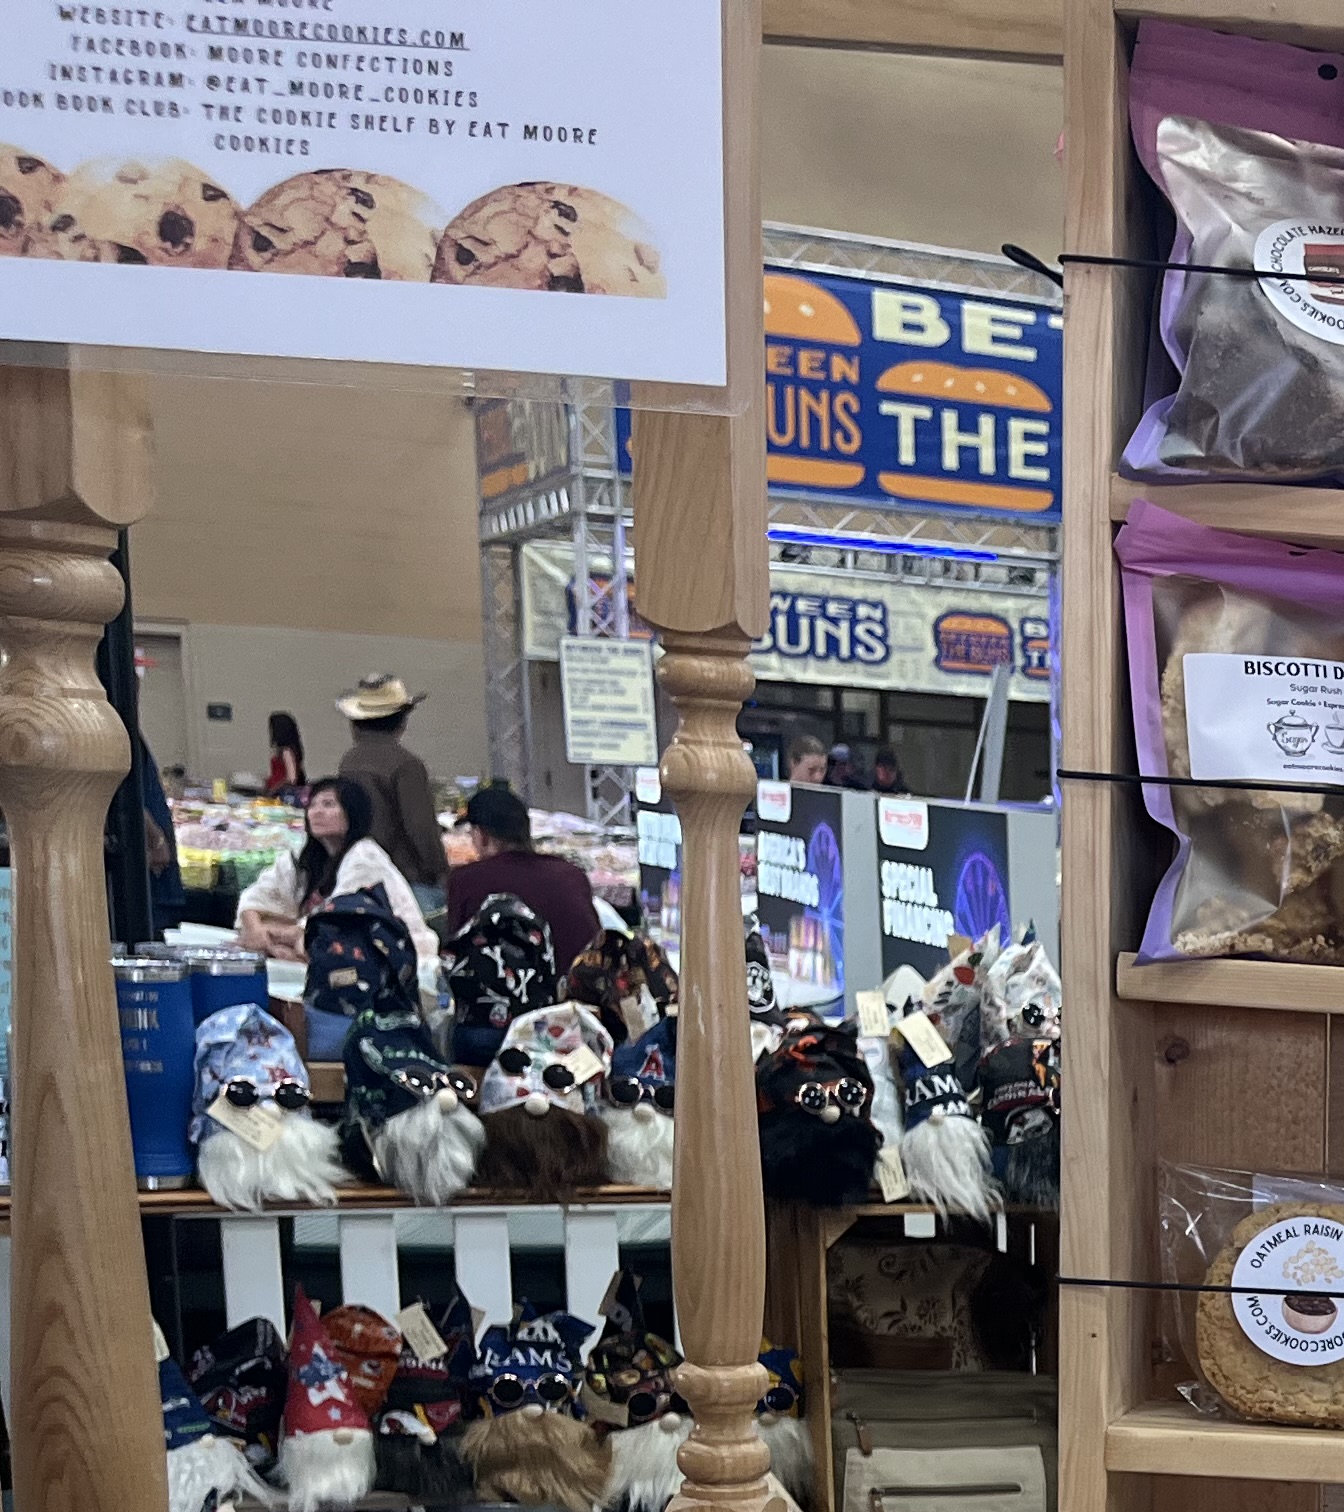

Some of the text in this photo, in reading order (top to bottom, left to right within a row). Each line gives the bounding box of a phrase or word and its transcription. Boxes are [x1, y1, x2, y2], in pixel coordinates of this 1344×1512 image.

[186, 14, 466, 48] EATMOORECOOKIES.COM
[208, 45, 284, 67] MOORE
[297, 51, 453, 77] CONFECTIONS
[207, 75, 479, 108] @EAT_MOORE_COOKIES
[56, 93, 114, 114] BOOK
[202, 103, 243, 124] THE
[257, 106, 338, 129] COOKIE
[350, 113, 416, 133] SHELF
[429, 118, 456, 136] BY
[468, 120, 510, 140] EAT
[523, 124, 598, 146] MOORE
[214, 133, 310, 156] COOKIES
[879, 400, 1051, 481] THE
[1244, 660, 1328, 678] BISCOTTI
[1290, 684, 1342, 695] Sugar Rush
[1250, 1229, 1301, 1270] OATMEAL
[1303, 1223, 1344, 1242] RAISIN
